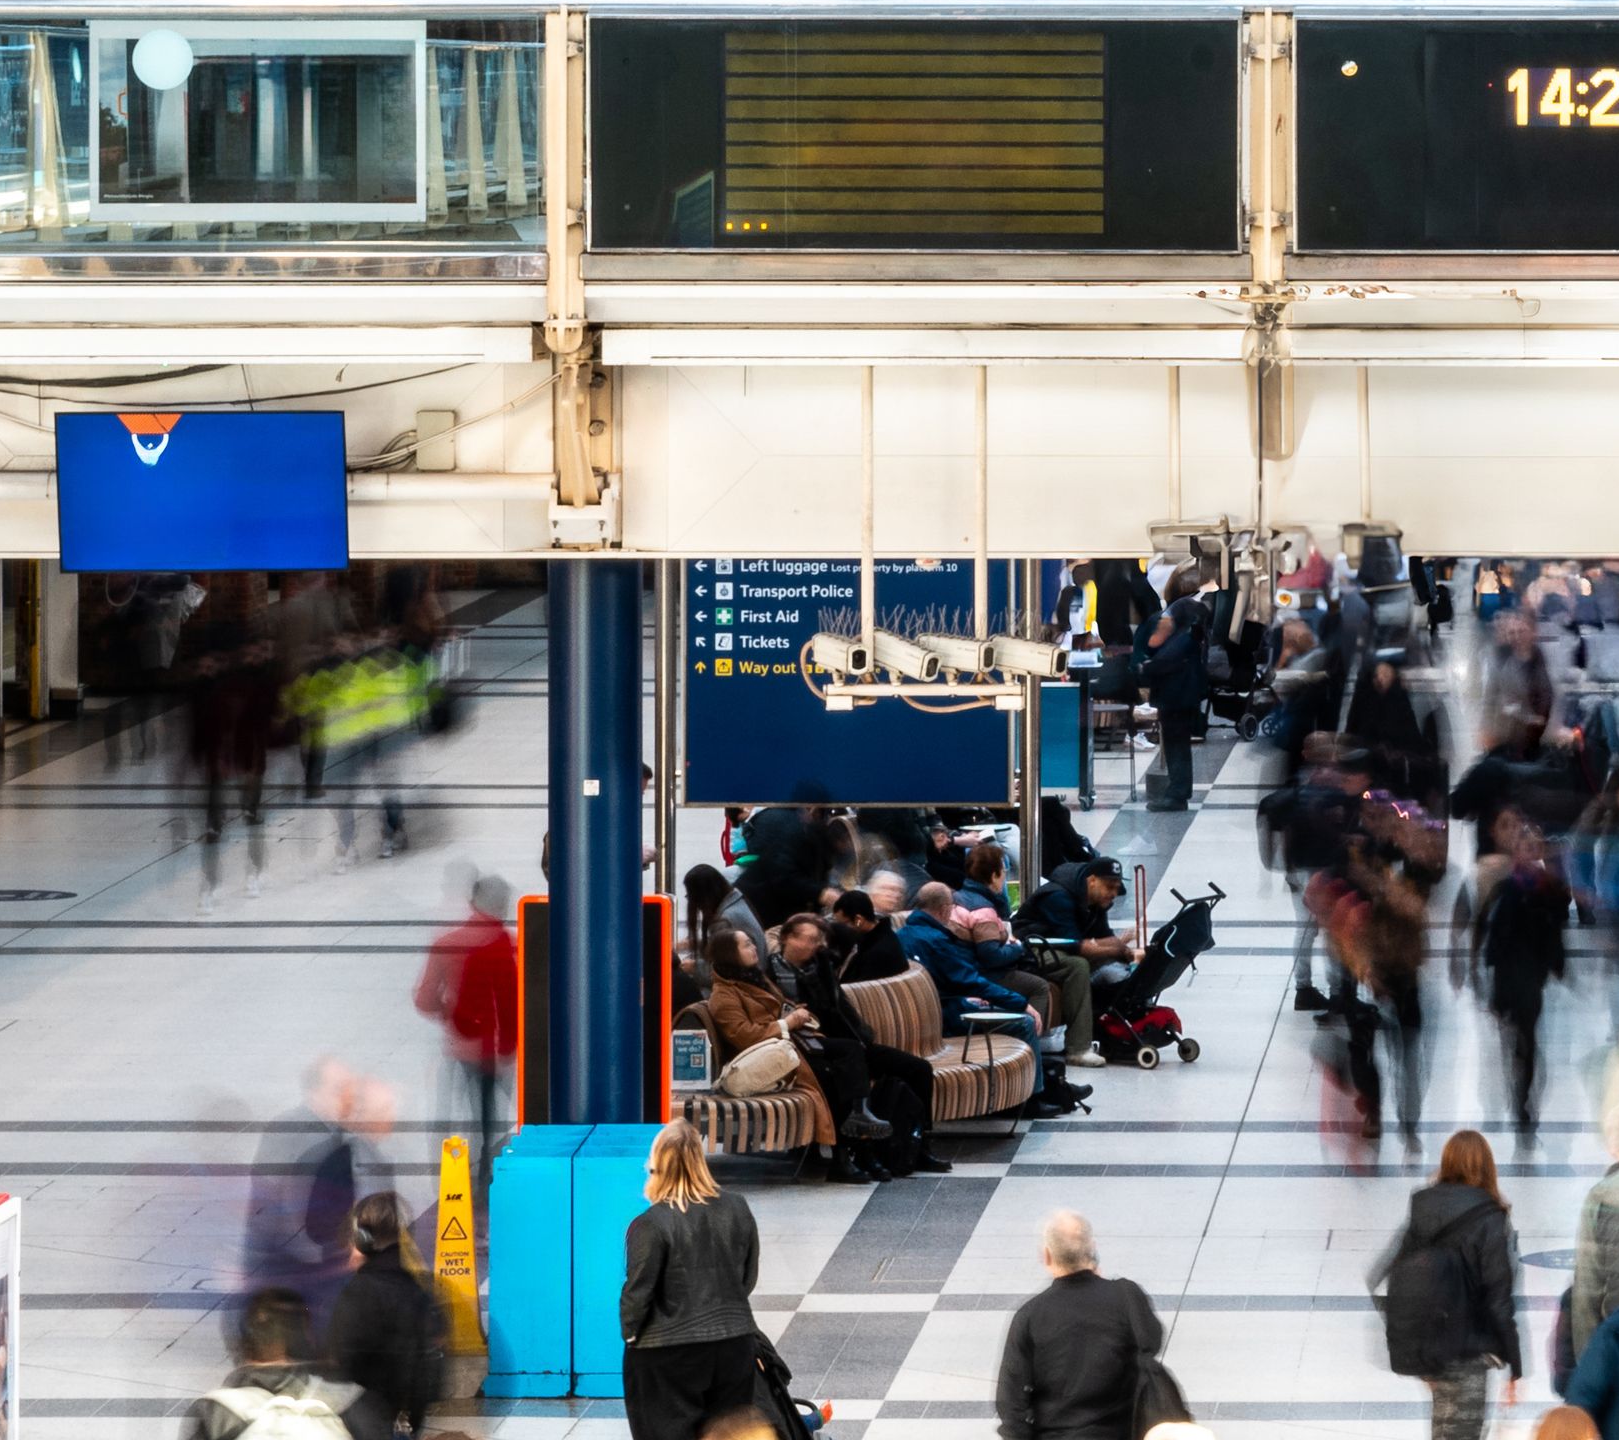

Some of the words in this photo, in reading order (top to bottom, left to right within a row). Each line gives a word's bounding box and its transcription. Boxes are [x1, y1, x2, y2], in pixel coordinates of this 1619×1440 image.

[740, 559, 770, 573] Left
[772, 559, 828, 575] luggage
[831, 563, 850, 573] Lost
[852, 564, 891, 575] prerty
[892, 563, 904, 574] by
[945, 563, 958, 573] 10
[739, 584, 808, 600] Transport
[811, 584, 854, 598] Police
[740, 609, 772, 624] First
[775, 609, 799, 623] Aid
[739, 635, 790, 649] Tickets
[738, 660, 770, 677] Way
[772, 662, 797, 674] out
[444, 1257, 465, 1267] WET
[438, 1266, 471, 1276] FLOOR
